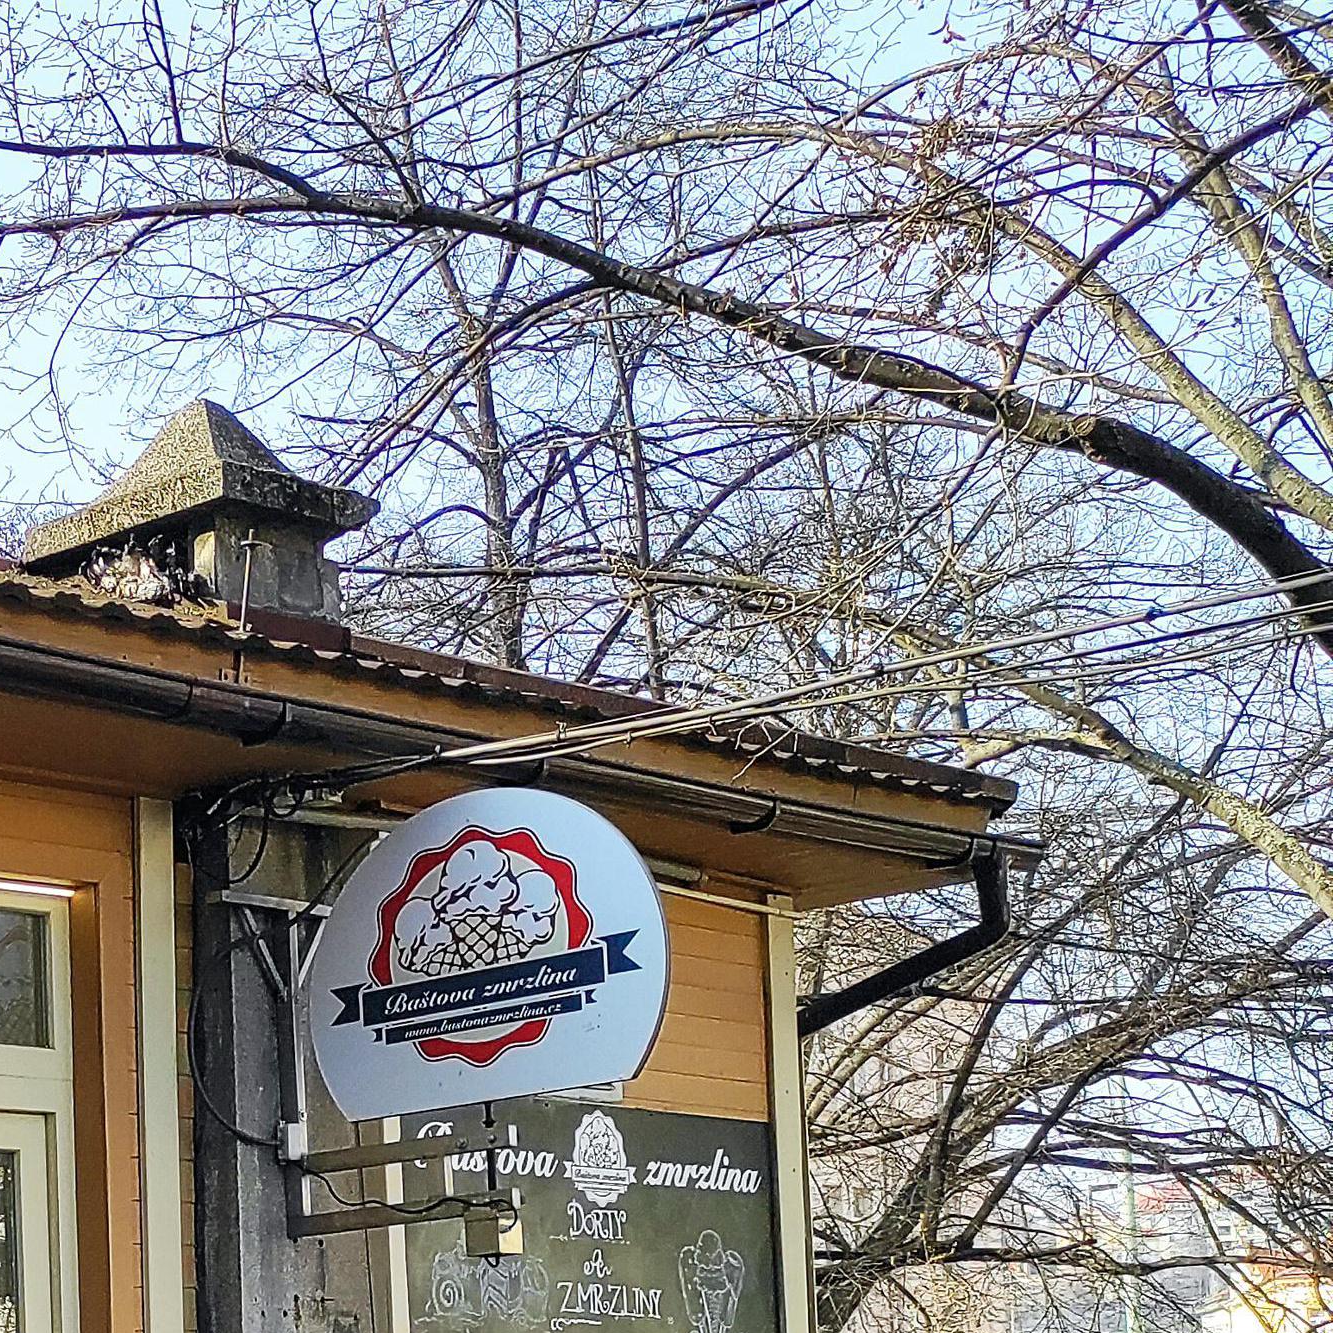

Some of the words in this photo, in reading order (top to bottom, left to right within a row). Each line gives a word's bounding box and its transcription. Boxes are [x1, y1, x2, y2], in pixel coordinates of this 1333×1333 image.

[384, 990, 477, 1017] Baštova
[483, 964, 579, 998] zmrzlina
[643, 1149, 762, 1194] zmrzlina
[556, 1281, 663, 1320] ZMRZLINY
